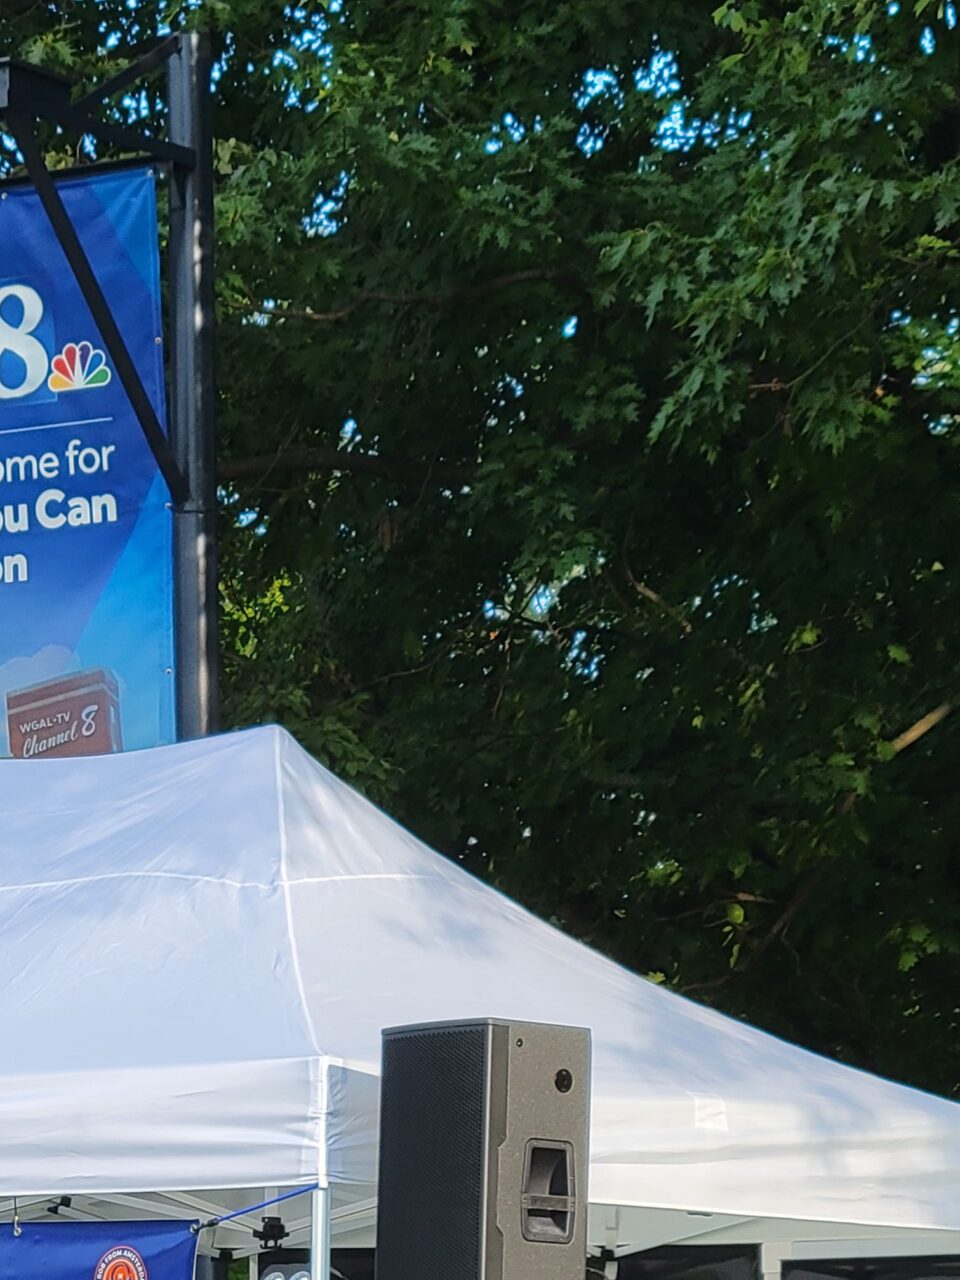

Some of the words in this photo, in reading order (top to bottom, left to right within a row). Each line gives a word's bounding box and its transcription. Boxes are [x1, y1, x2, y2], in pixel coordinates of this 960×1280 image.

[66, 439, 116, 475] for
[35, 489, 117, 529] Can
[23, 721, 79, 757] Channel
[81, 705, 98, 736] 8
[96, 1263, 106, 1280] ROB
[105, 1249, 122, 1263] FROM
